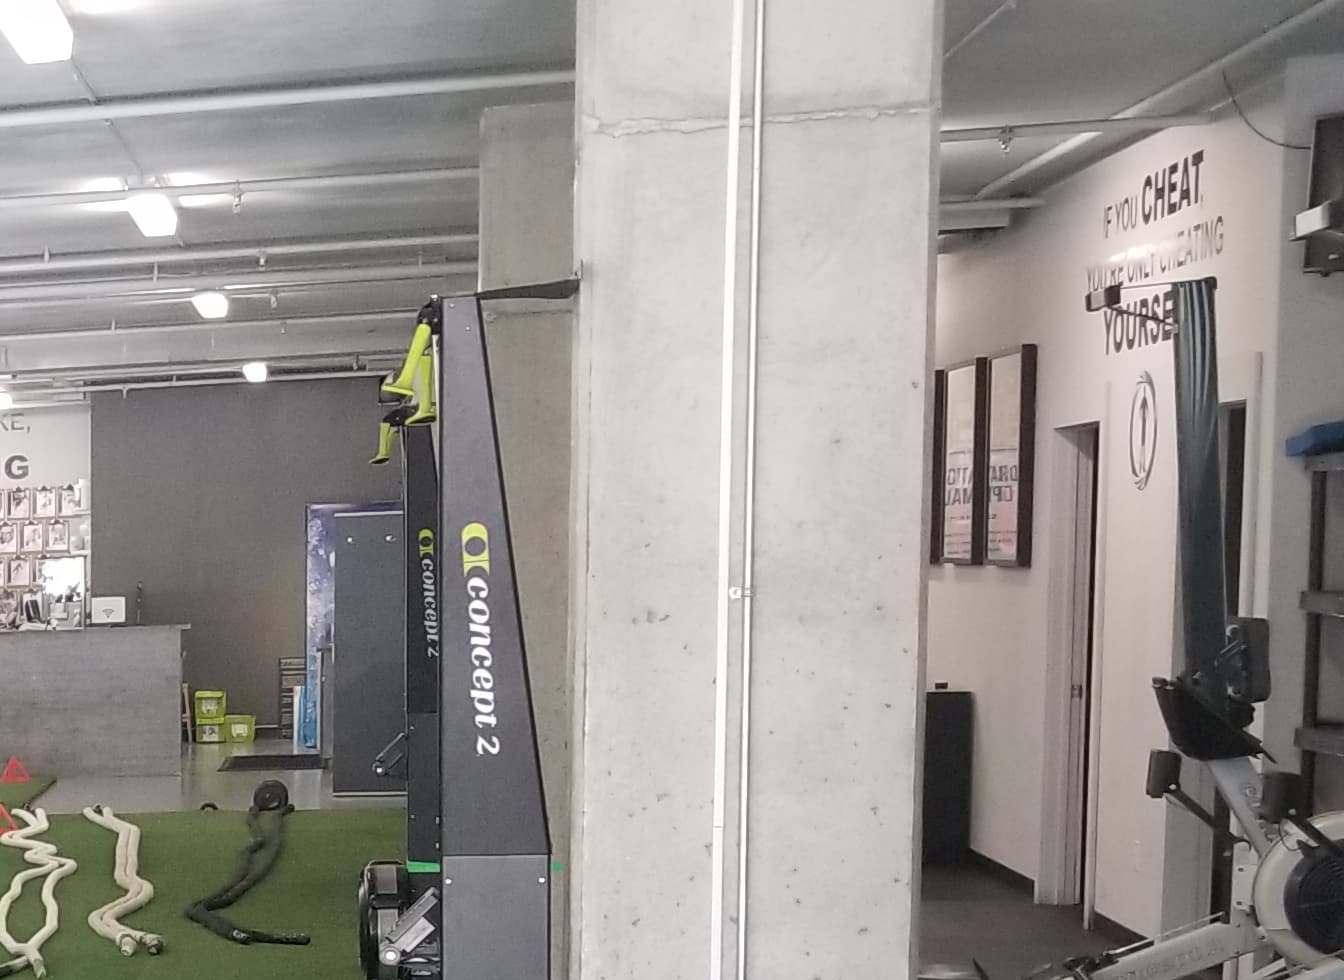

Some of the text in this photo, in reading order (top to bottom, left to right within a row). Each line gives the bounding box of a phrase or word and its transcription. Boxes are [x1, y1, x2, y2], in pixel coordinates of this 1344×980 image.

[1104, 206, 1113, 239] IF
[1115, 196, 1138, 232] YOU
[1160, 214, 1224, 274] CHEATING
[1104, 289, 1177, 356] YOURSE
[421, 558, 439, 658] concept 2
[467, 576, 500, 756] concept 2
